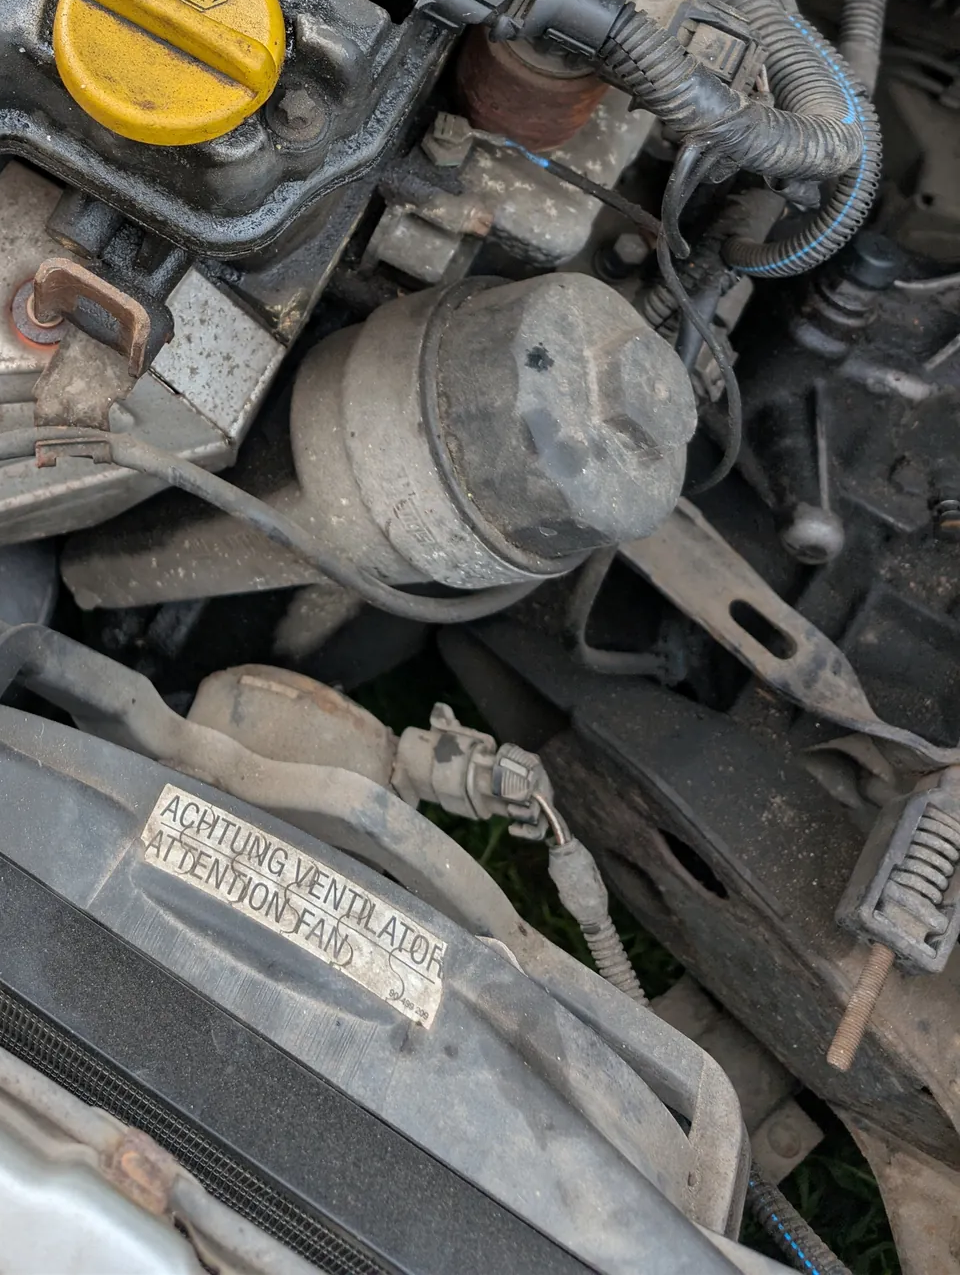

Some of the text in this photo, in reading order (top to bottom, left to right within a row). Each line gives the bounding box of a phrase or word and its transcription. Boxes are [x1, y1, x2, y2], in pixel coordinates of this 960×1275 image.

[146, 829, 350, 960] ATTENTION FAN
[160, 794, 444, 979] ACHTUNG VENTILATOR
